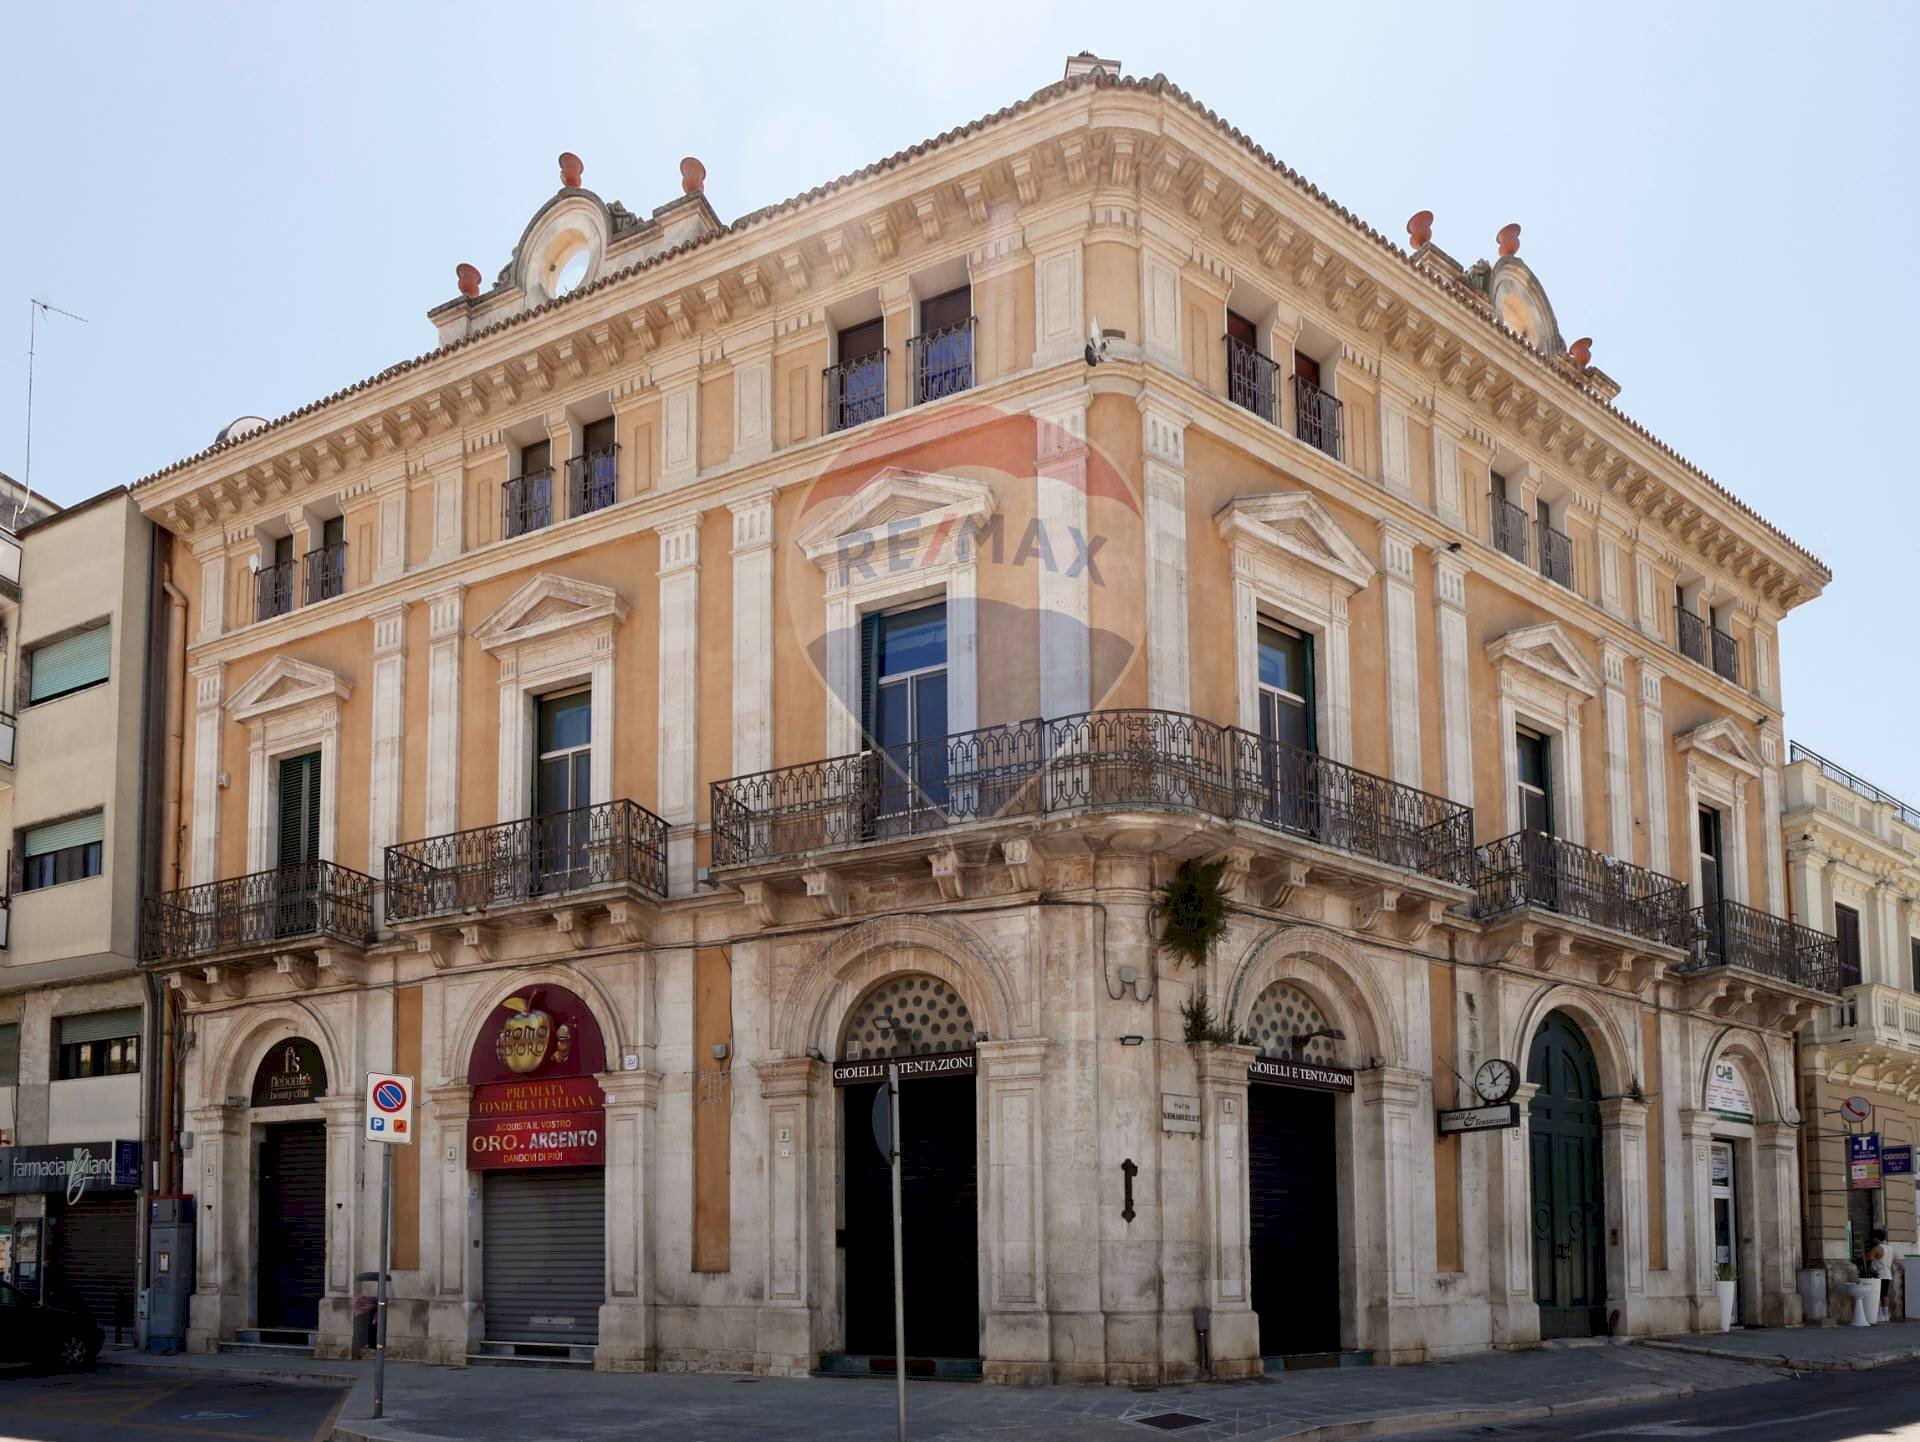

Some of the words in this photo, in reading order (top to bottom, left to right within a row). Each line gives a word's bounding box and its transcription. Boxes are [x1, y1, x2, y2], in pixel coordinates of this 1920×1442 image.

[503, 1025, 547, 1041] POMO
[503, 1041, 547, 1056] D'ORO
[834, 1064, 884, 1080] GIOIELLI
[898, 1056, 973, 1074] TENTAZIONI
[1249, 1061, 1290, 1078] GIOIELLI
[1292, 1067, 1298, 1078] E
[1299, 1068, 1353, 1086] TENTAZIONI
[1715, 1064, 1733, 1080] CAB
[506, 1084, 565, 1099] PREMIATA
[479, 1099, 536, 1113] FONDERIA
[539, 1095, 595, 1109] ITALIANA
[373, 1118, 383, 1130] P
[496, 1121, 532, 1131] ACQUISTA
[532, 1121, 539, 1129] IL
[541, 1119, 571, 1129] VOSTRO
[529, 1129, 598, 1149] ARGENTO
[503, 1153, 537, 1163] DANDOVI
[538, 1152, 546, 1161] DI
[13, 1156, 65, 1177] farmacia
